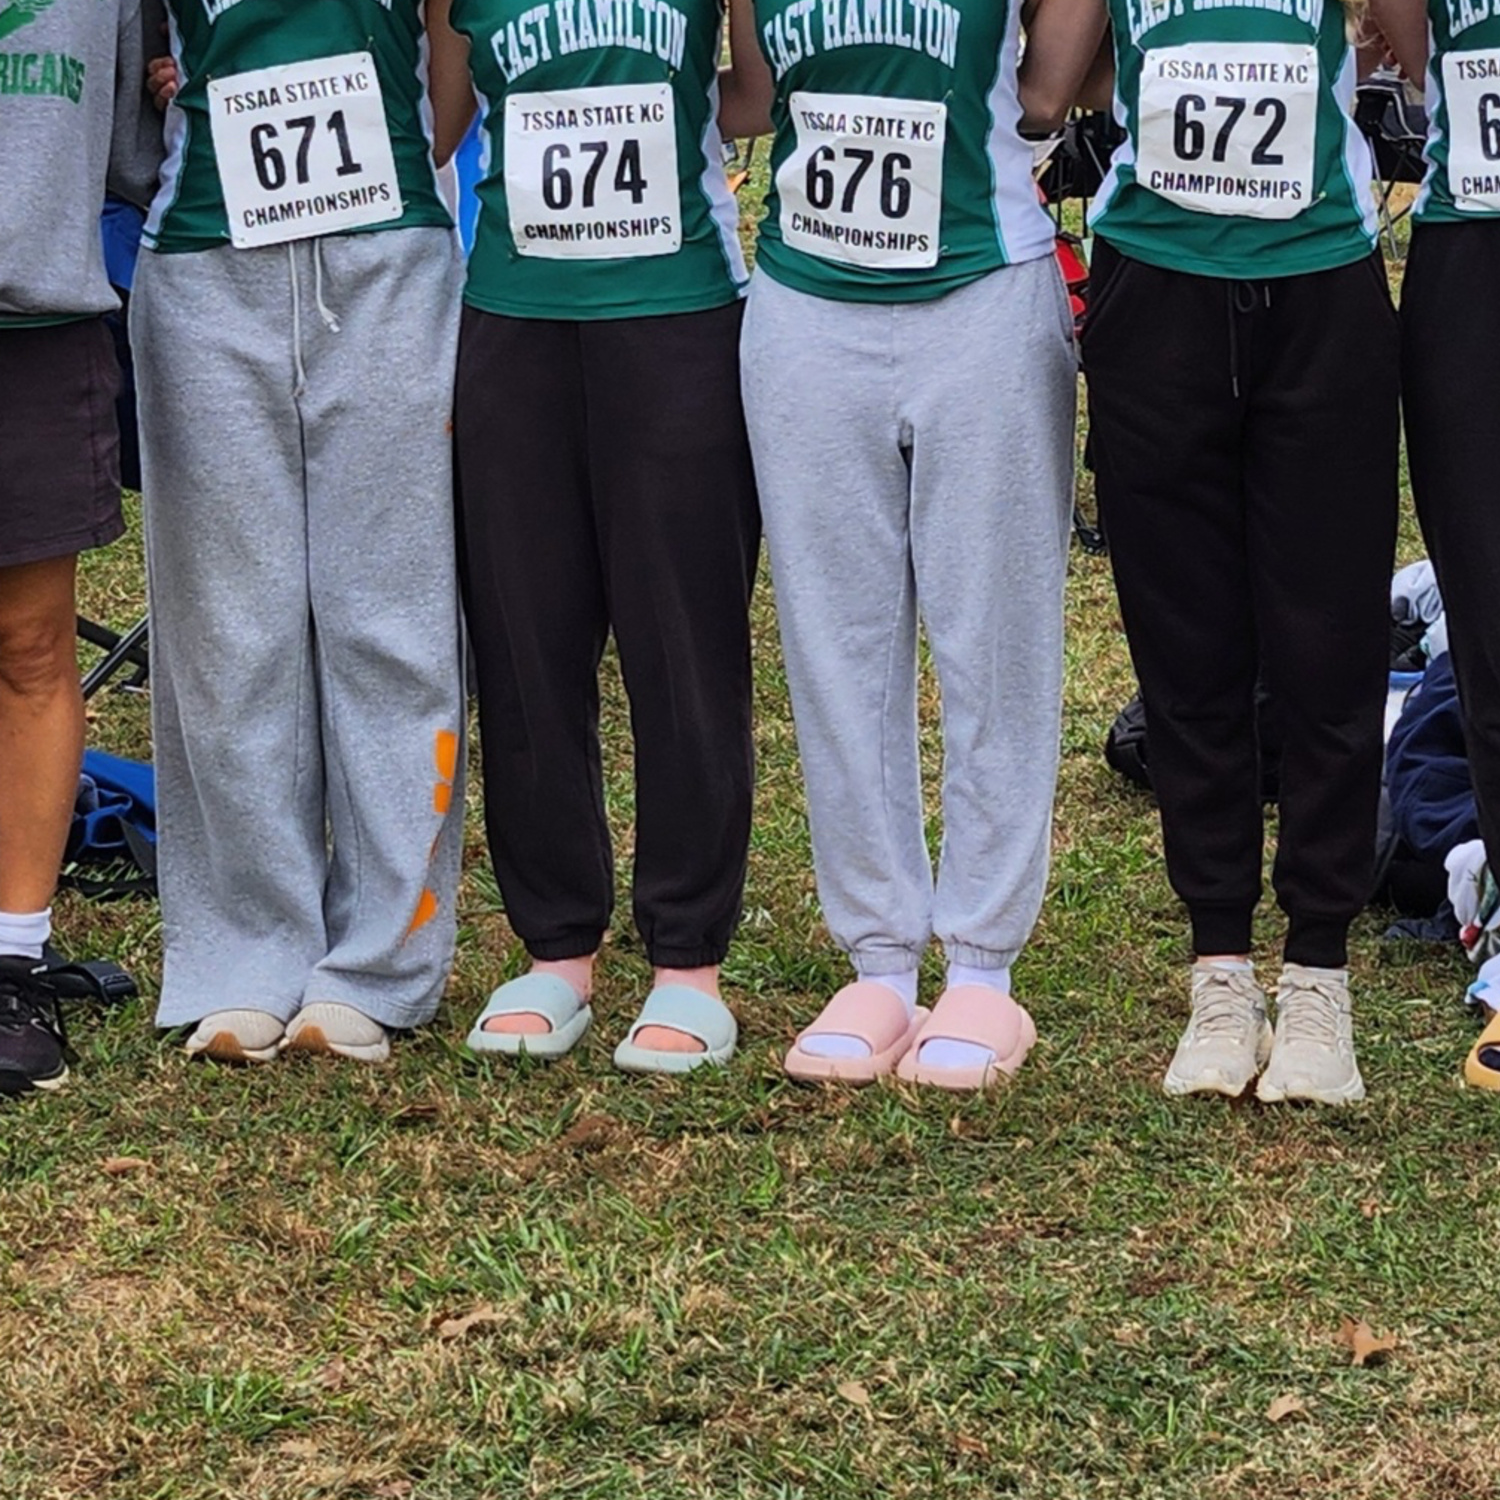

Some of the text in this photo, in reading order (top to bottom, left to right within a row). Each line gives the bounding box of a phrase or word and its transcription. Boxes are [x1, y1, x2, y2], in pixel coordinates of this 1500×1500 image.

[490, 3, 552, 84] EAST
[224, 71, 369, 116] TSSAA STATE XC
[1158, 60, 1309, 85] TSSAA STATE XC
[522, 103, 664, 132] TSSAA STATE XC
[800, 110, 936, 142] TSSAA STATE XC
[1173, 94, 1288, 166] 672
[249, 109, 363, 192] 671
[542, 139, 648, 210] 674
[805, 145, 913, 219] 676
[1150, 170, 1302, 200] CHAMPIONSHIPS
[243, 183, 391, 228] CHAMPIONSHIPS
[524, 217, 672, 241] CHAMPIONSHIPS
[791, 211, 930, 252] CHAMPIONSHIPS
